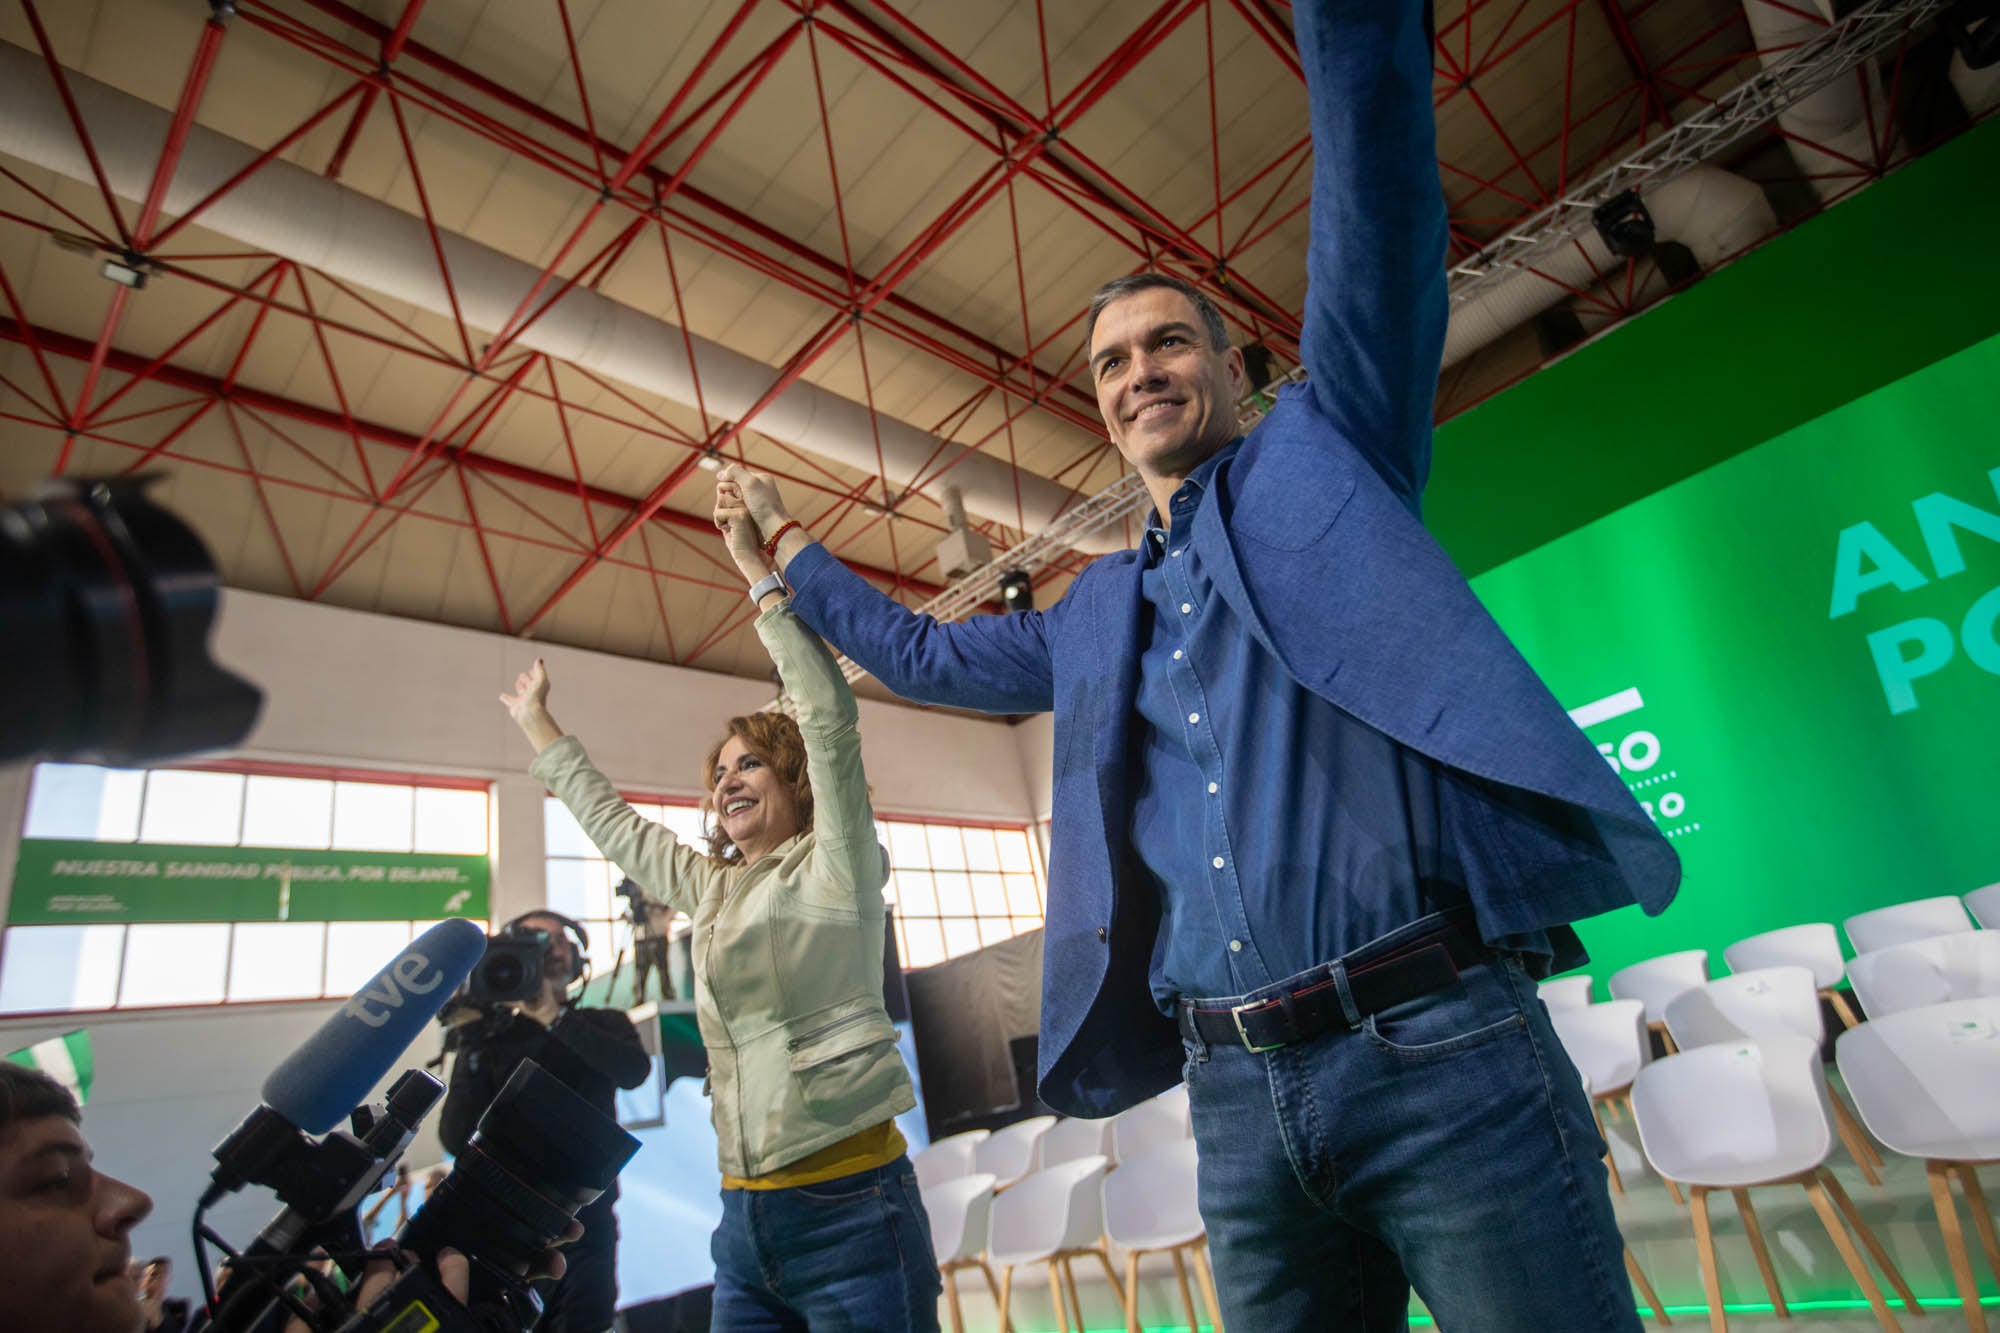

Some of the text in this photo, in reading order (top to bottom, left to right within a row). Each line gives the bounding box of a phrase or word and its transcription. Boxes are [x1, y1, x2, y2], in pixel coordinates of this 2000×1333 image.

[53, 860, 158, 877] NUESTRA
[165, 862, 261, 879] SANIDAD
[348, 865, 386, 881] POR
[345, 952, 444, 1028] tve
